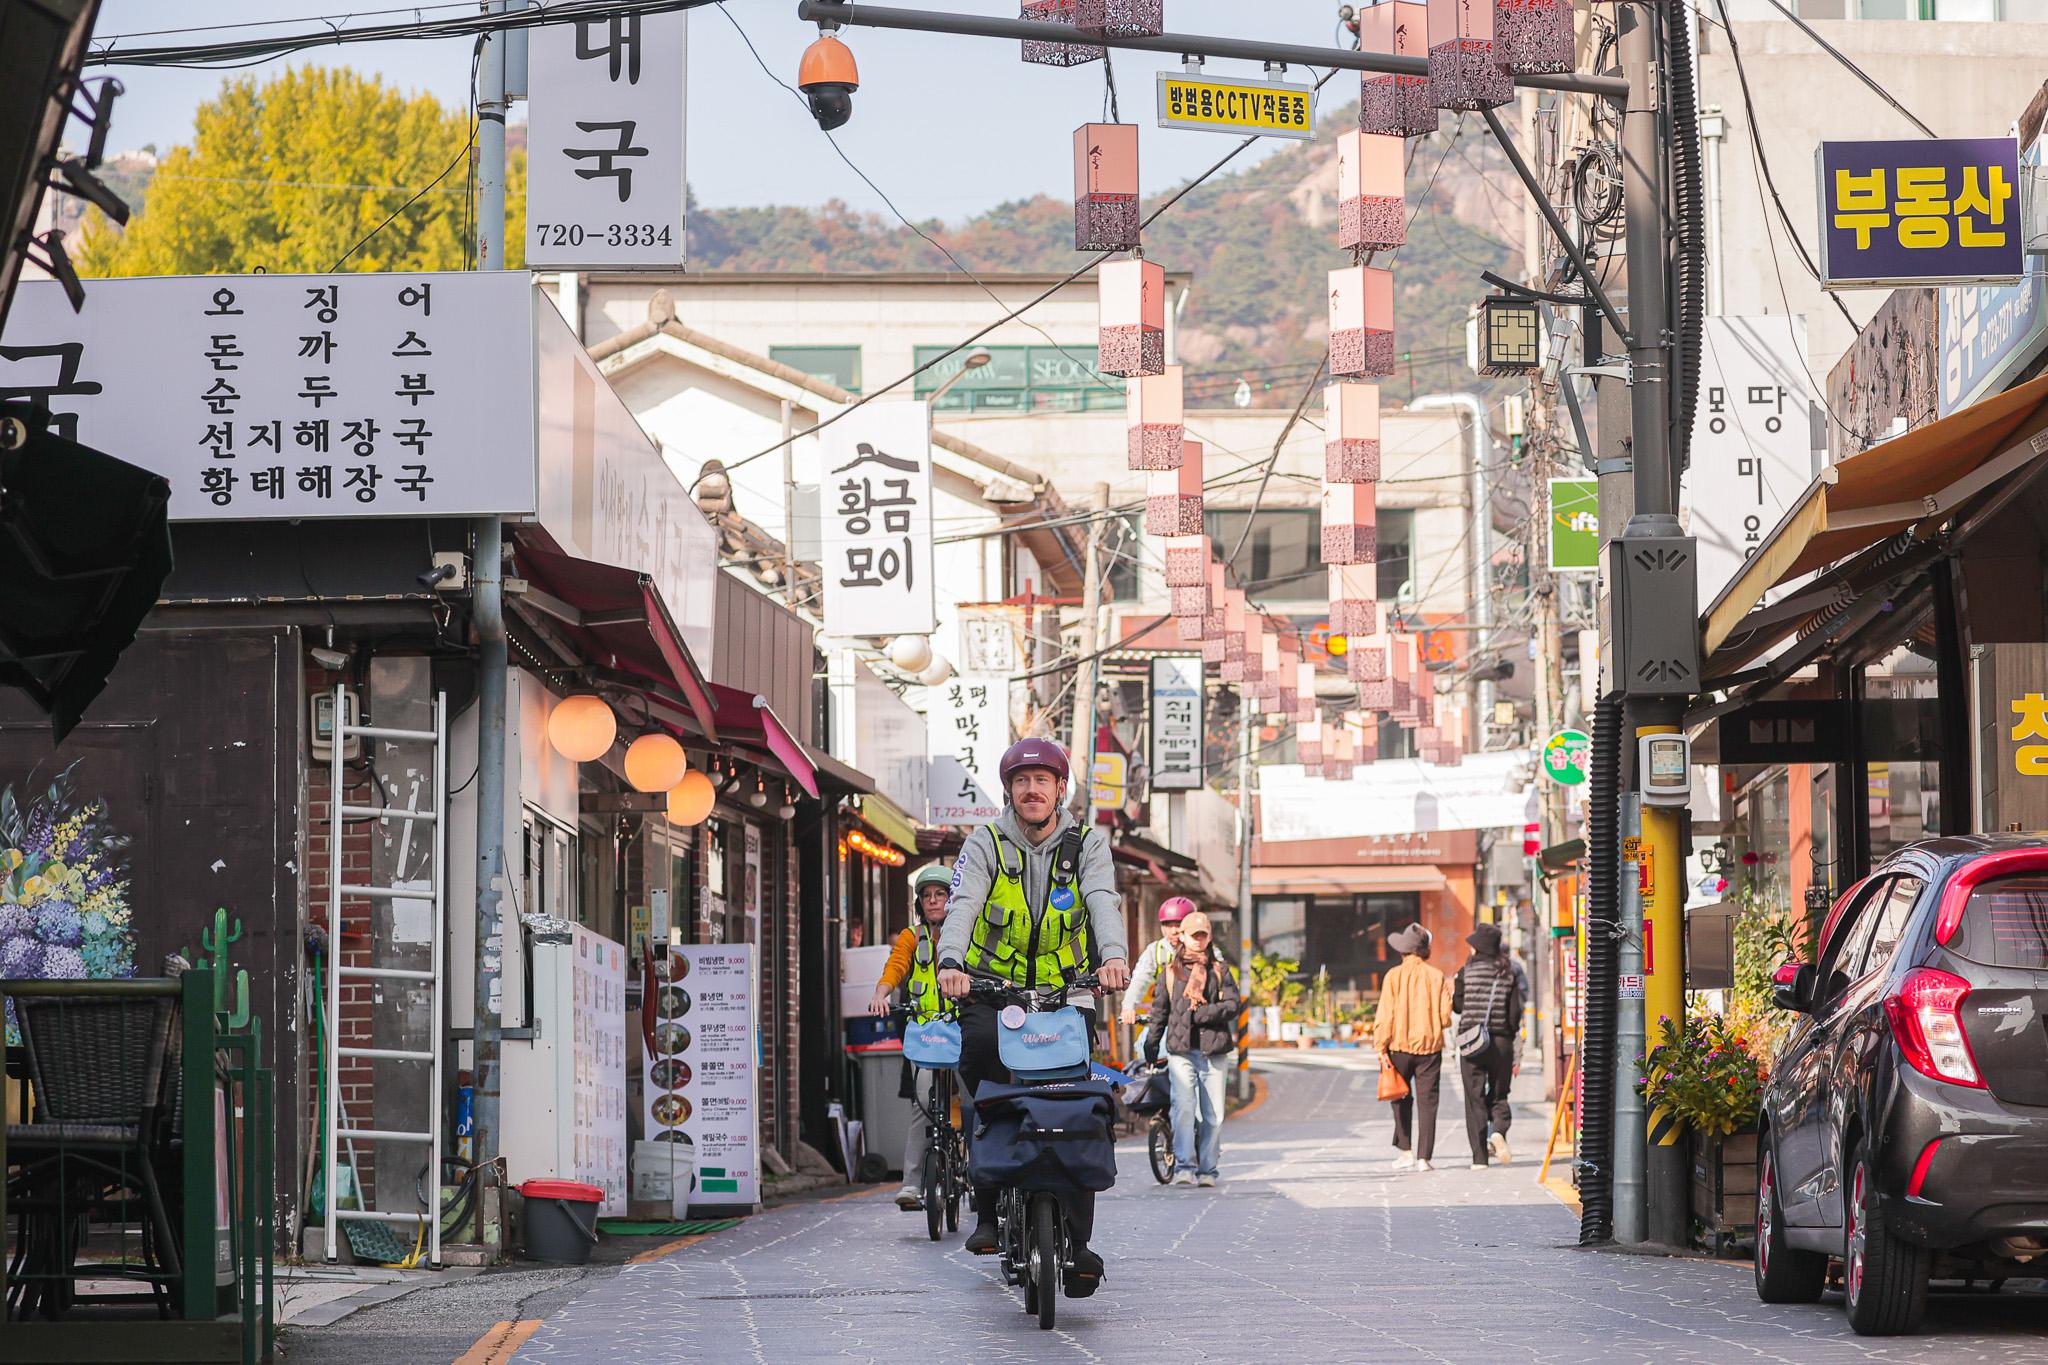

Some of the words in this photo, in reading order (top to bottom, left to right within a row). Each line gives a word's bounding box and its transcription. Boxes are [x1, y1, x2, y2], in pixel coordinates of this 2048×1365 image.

[564, 13, 650, 204] 대국
[1169, 84, 1306, 126] 방범용CCTV작동중
[1834, 165, 2012, 249] 부동산
[537, 225, 672, 246] 720-3334
[204, 283, 430, 323] 오징어
[204, 331, 432, 370] 돈까스
[201, 374, 434, 414] 순두부
[199, 419, 432, 458] 선지해장국
[200, 465, 434, 506] 황태해장국
[838, 478, 916, 538] 황금
[840, 537, 912, 591] 모이
[949, 685, 988, 708] 봉평
[955, 714, 981, 803] 막국수
[933, 806, 1000, 820] T.723-4830
[699, 956, 725, 965] 비빔냉면
[700, 992, 723, 1001] 물냉면
[700, 1024, 726, 1032] 열무냉면
[1021, 1032, 1062, 1044] WeRide
[702, 1133, 728, 1142] 메밀국수
